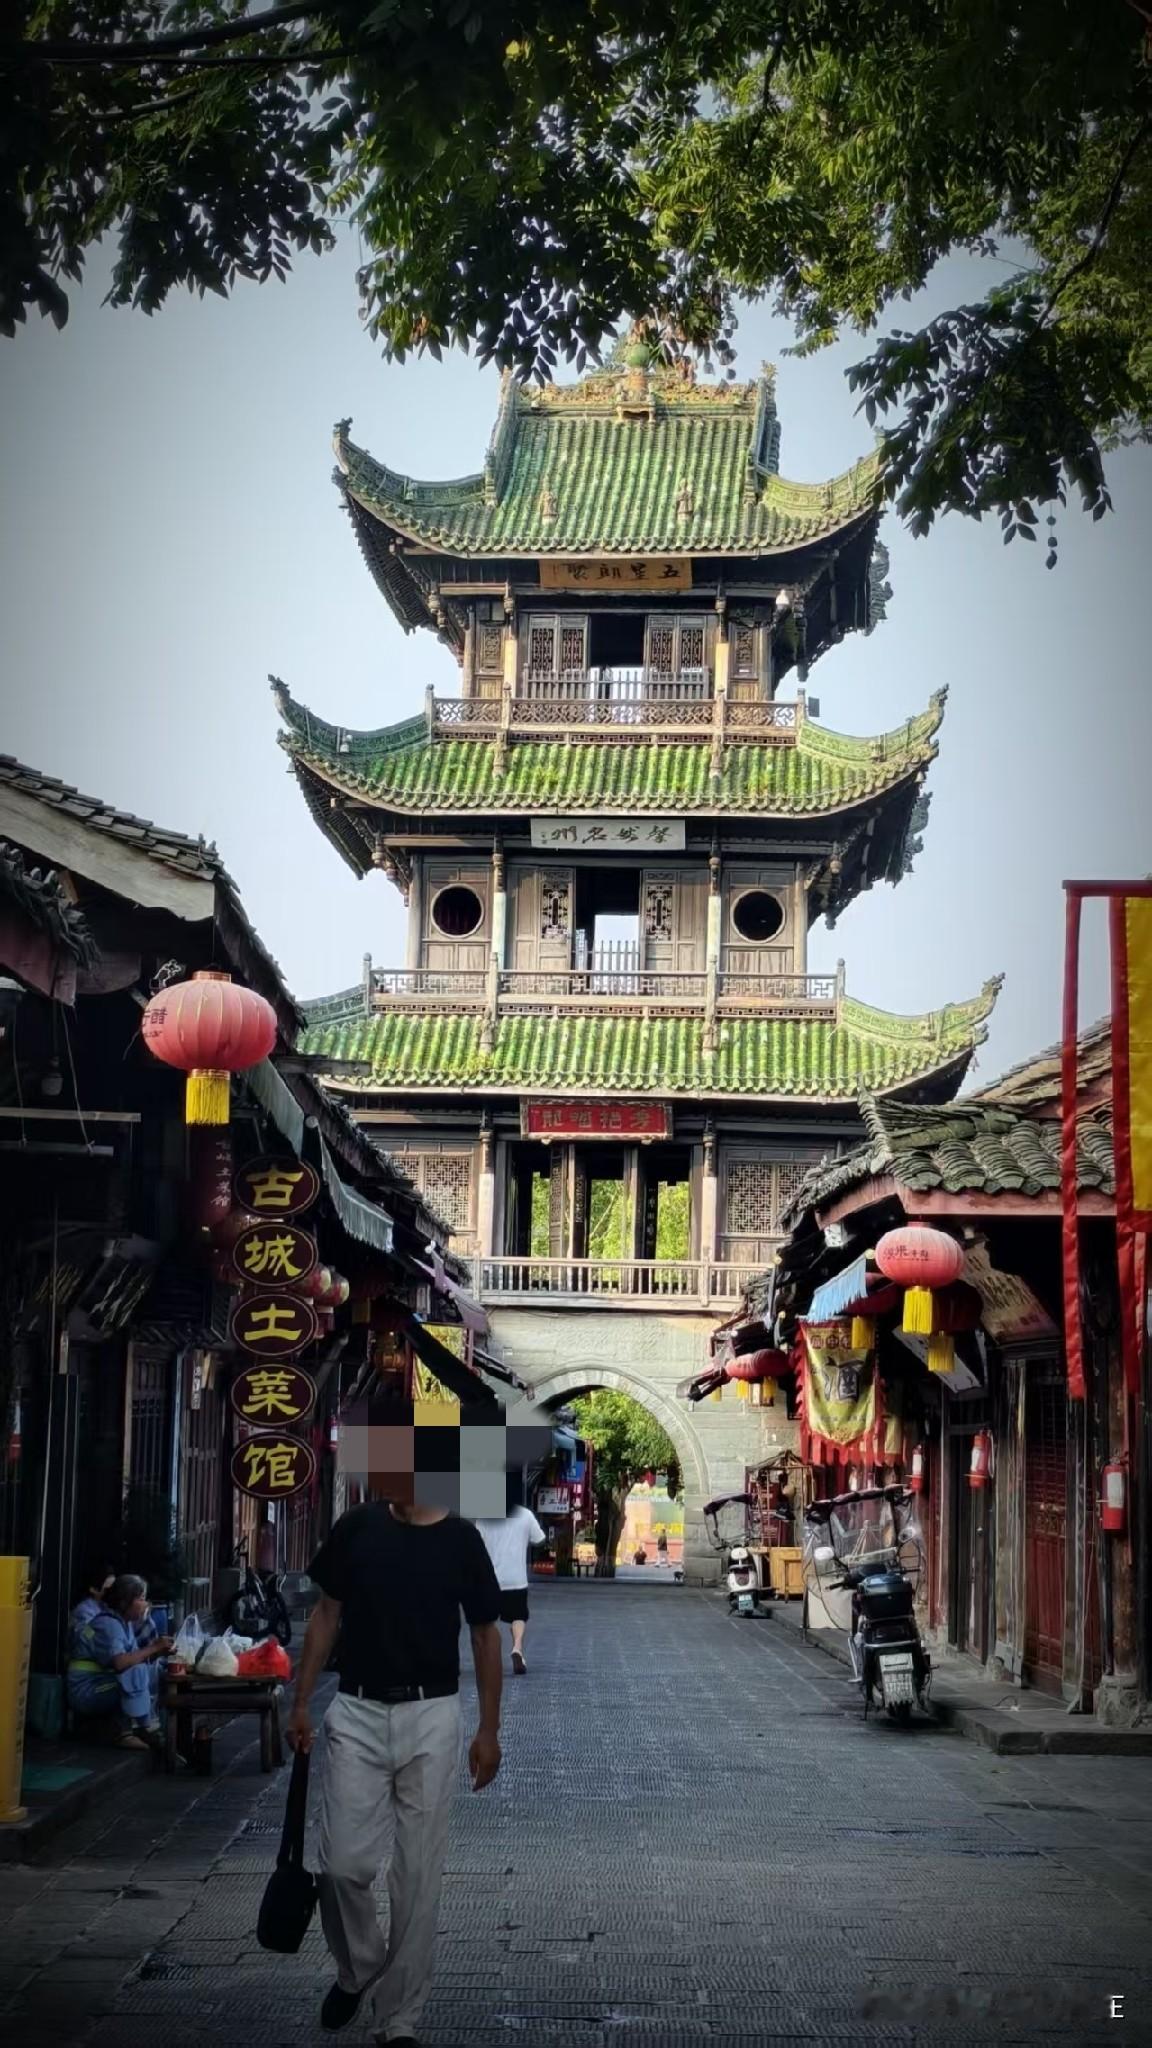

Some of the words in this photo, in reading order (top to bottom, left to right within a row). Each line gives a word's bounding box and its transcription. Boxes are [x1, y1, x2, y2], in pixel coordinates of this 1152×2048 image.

[242, 1165, 304, 1488] 古城土菜馆
